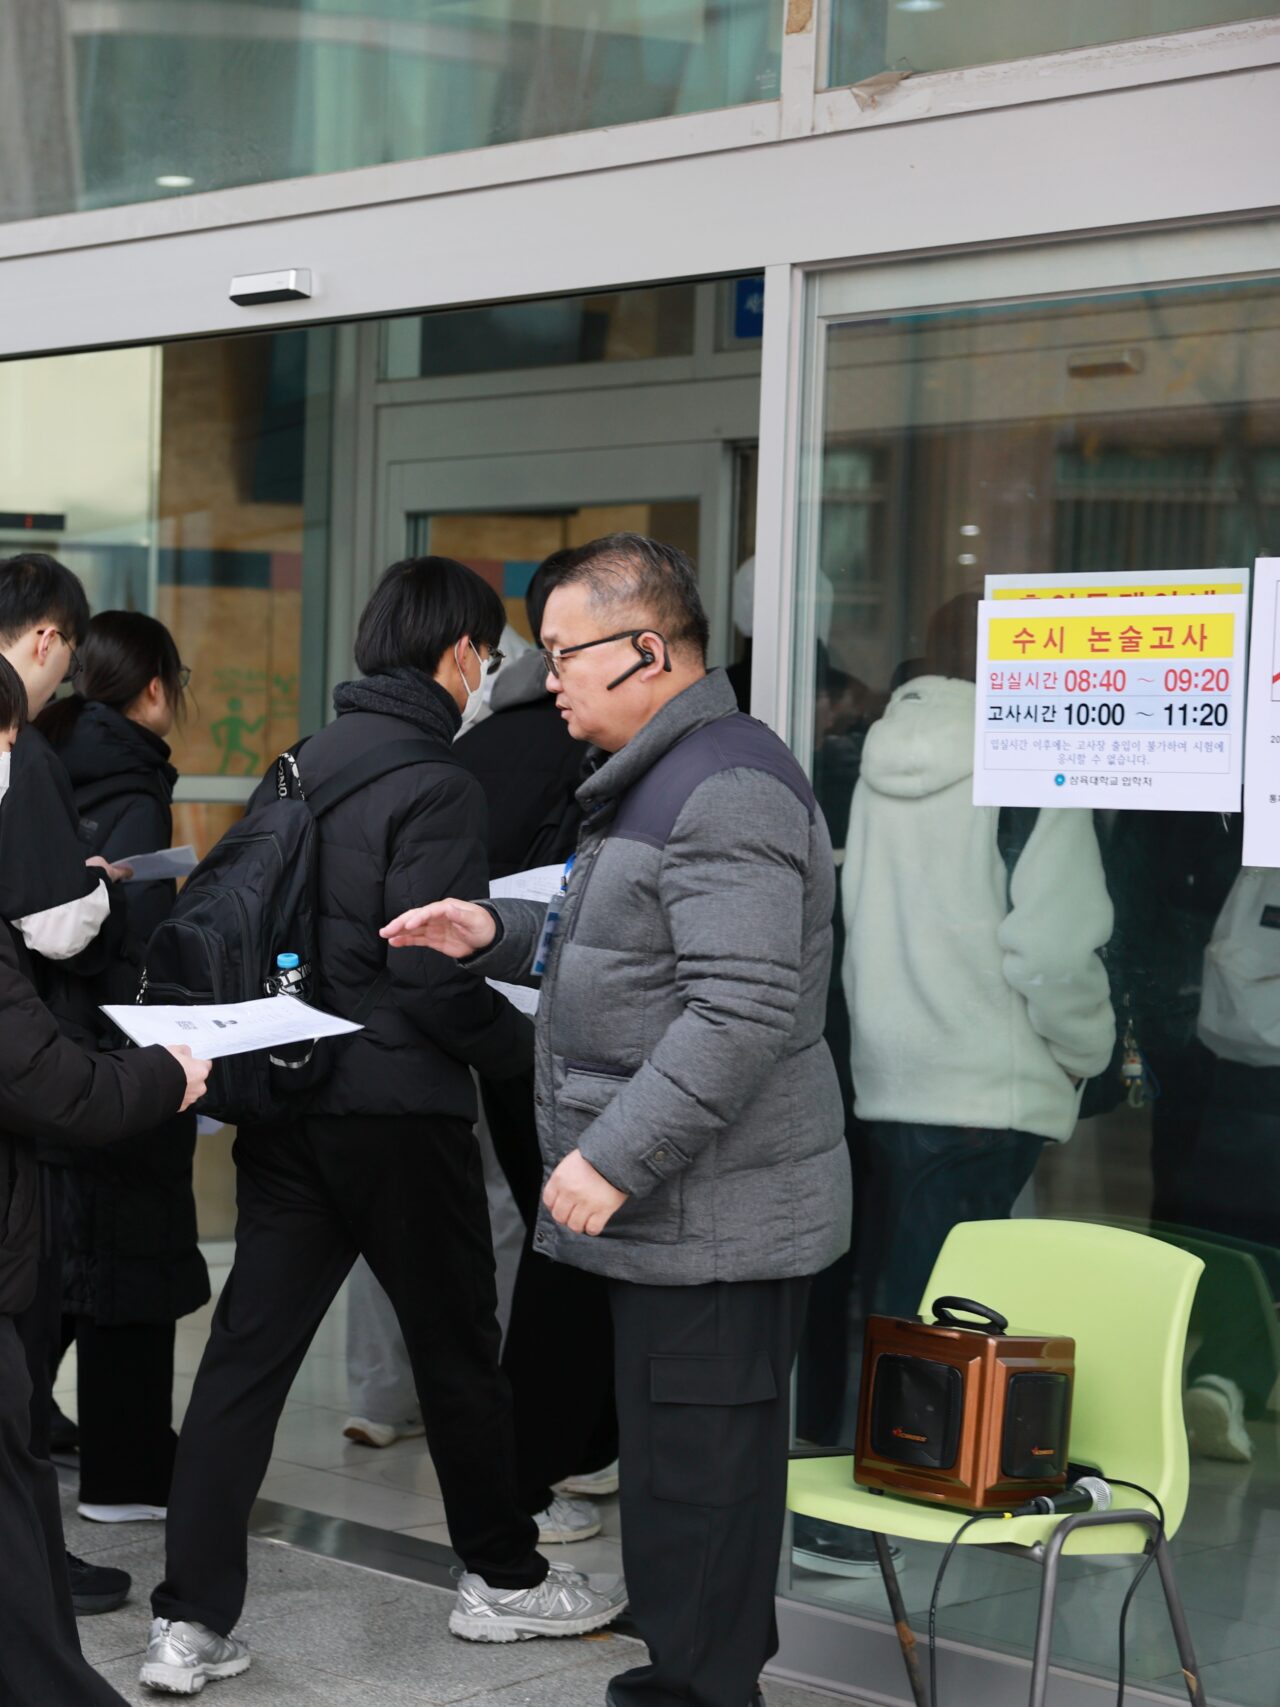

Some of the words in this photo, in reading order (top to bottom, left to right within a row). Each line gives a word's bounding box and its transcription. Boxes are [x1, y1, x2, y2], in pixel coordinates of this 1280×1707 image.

[1012, 626, 1065, 655] 수시
[1087, 623, 1208, 653] 논술고사
[990, 671, 1058, 691] 입실시간
[1064, 669, 1127, 693] 08:40
[1164, 668, 1230, 692] 09:20
[987, 704, 1057, 723] 고사시간
[1064, 702, 1125, 726] 10:00
[1164, 702, 1228, 727] 11:20
[990, 738, 1029, 751] 입실시간
[1077, 739, 1106, 752] 고사장
